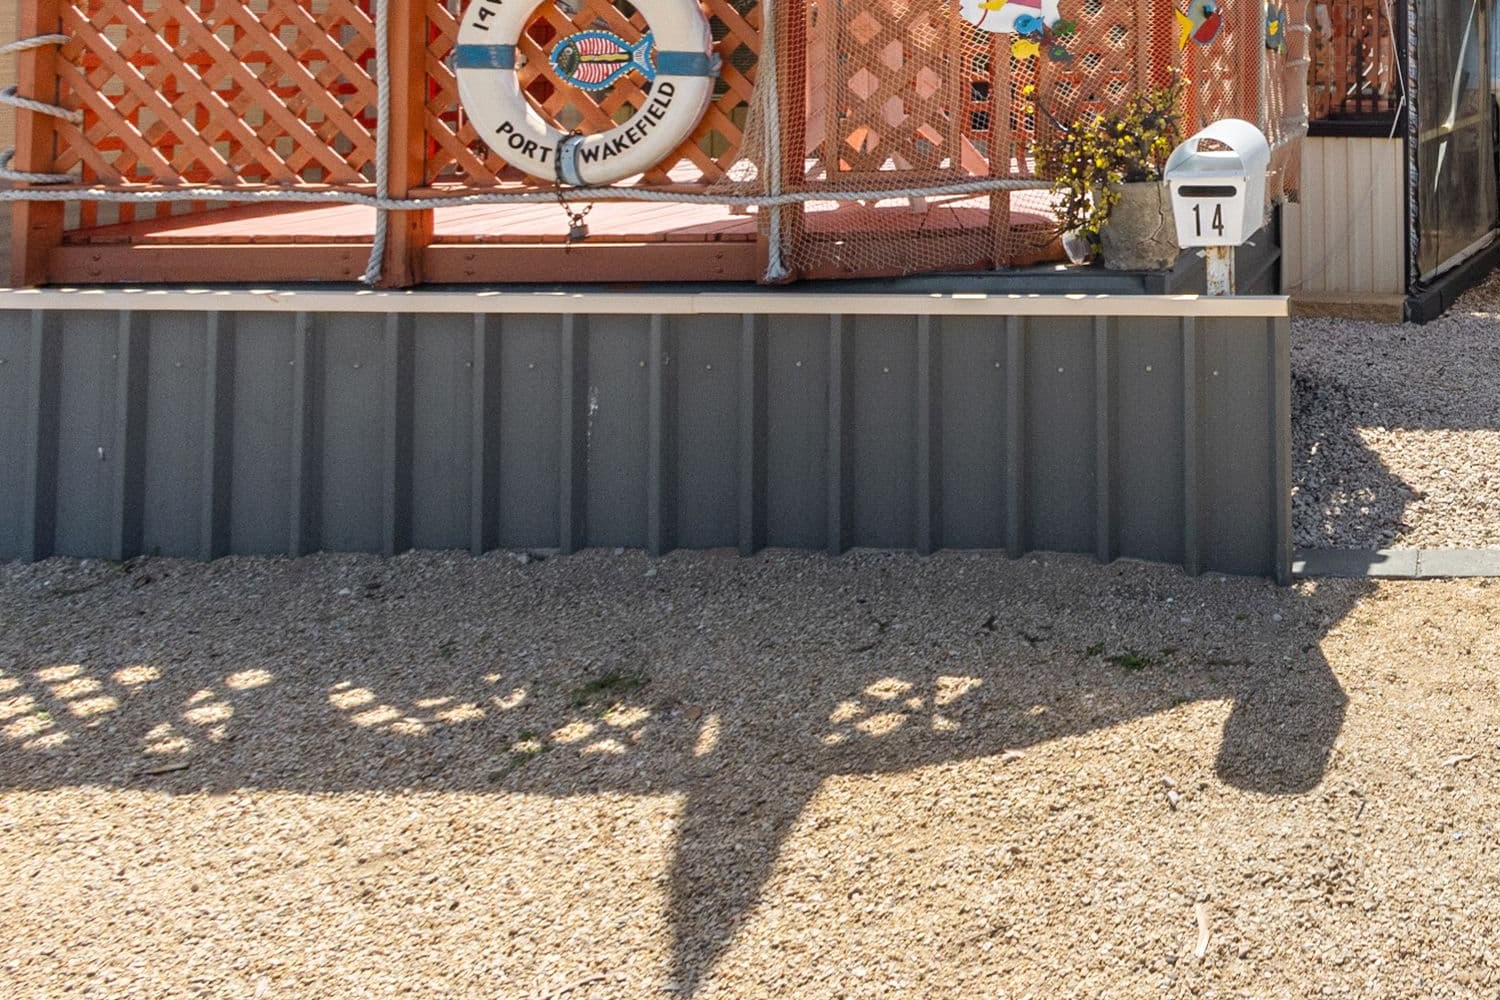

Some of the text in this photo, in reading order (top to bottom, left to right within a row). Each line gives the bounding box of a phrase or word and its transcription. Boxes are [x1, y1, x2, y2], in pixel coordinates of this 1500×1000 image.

[496, 81, 675, 165] PORT WAKEFIELD
[1192, 203, 1224, 237] 14
